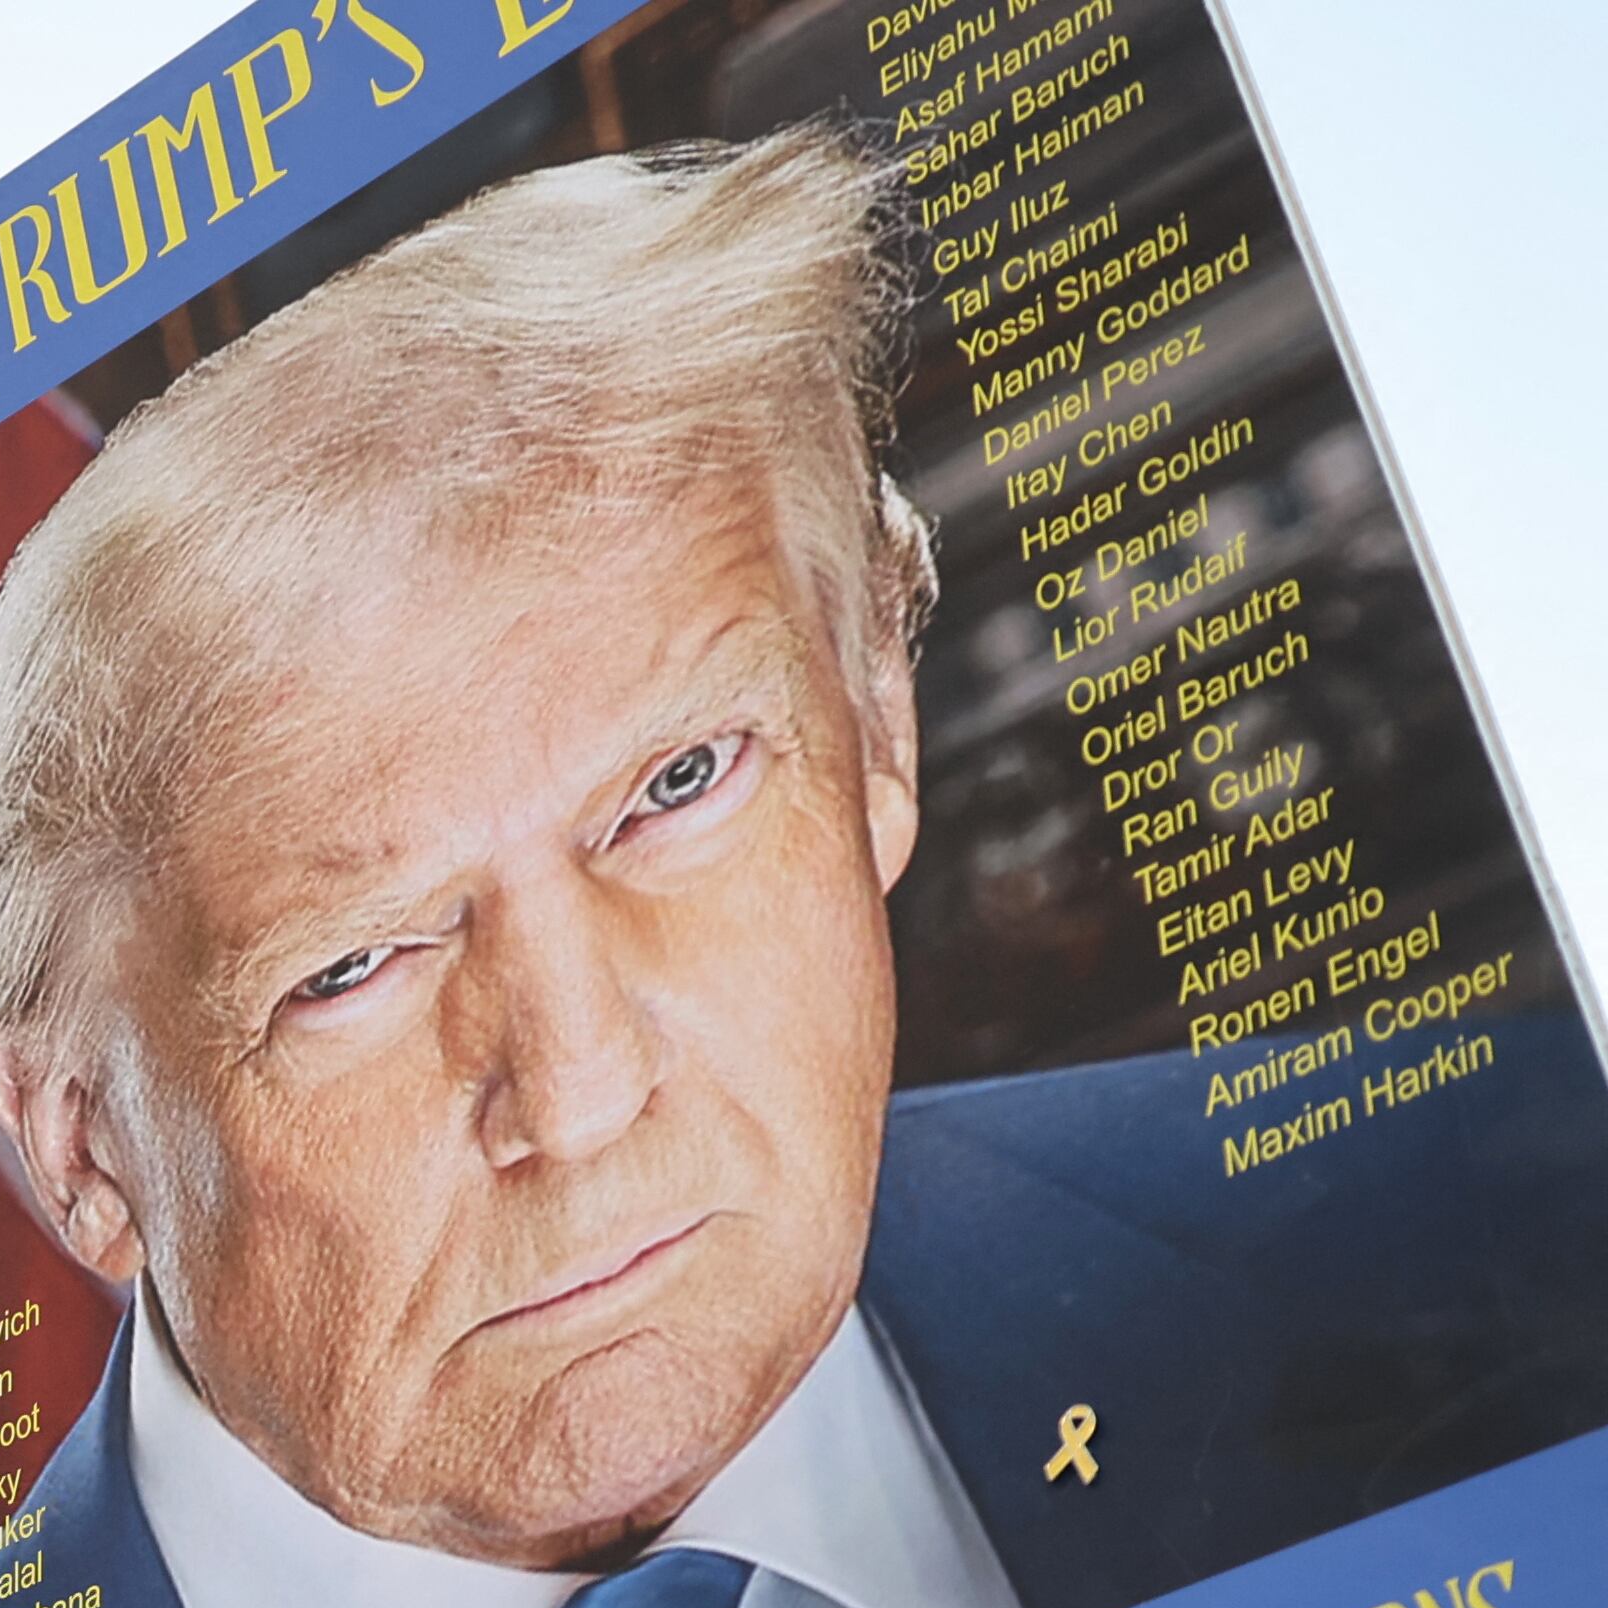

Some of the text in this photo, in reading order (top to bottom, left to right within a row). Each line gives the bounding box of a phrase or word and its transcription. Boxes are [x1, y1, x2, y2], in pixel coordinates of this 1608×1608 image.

[880, 9, 997, 95] Eliyahu
[896, 72, 966, 142] Asaf
[906, 35, 1131, 184] Sahar Baruch
[922, 81, 1145, 228] Inbar Haiman
[933, 221, 1000, 275] Guy
[944, 202, 1120, 324] Tal Chaimi
[956, 212, 1189, 364] Yossi Sharabi
[972, 234, 1251, 416] Manny Goddard
[983, 326, 1206, 465] Daniel Perez
[1007, 401, 1173, 508] Itay Chen
[1021, 418, 1255, 560] Hadar Goldin
[1035, 495, 1208, 610] Oz Daniel
[1053, 533, 1246, 661] Lior Rudaif
[1066, 579, 1302, 715] Omer Nautra
[1082, 633, 1310, 766] Oriel Baruch
[1103, 722, 1239, 811] Dror Or
[1123, 745, 1304, 856] Ran Guily
[1134, 787, 1334, 903] Tamir Adar
[1158, 840, 1355, 956] Eitan Levy
[1179, 887, 1386, 1005] Ariel Kunio
[1190, 912, 1441, 1057] Ronen Engel
[1204, 952, 1514, 1118] Amiram Cooper
[1222, 1035, 1496, 1179] Maxim Harkin
